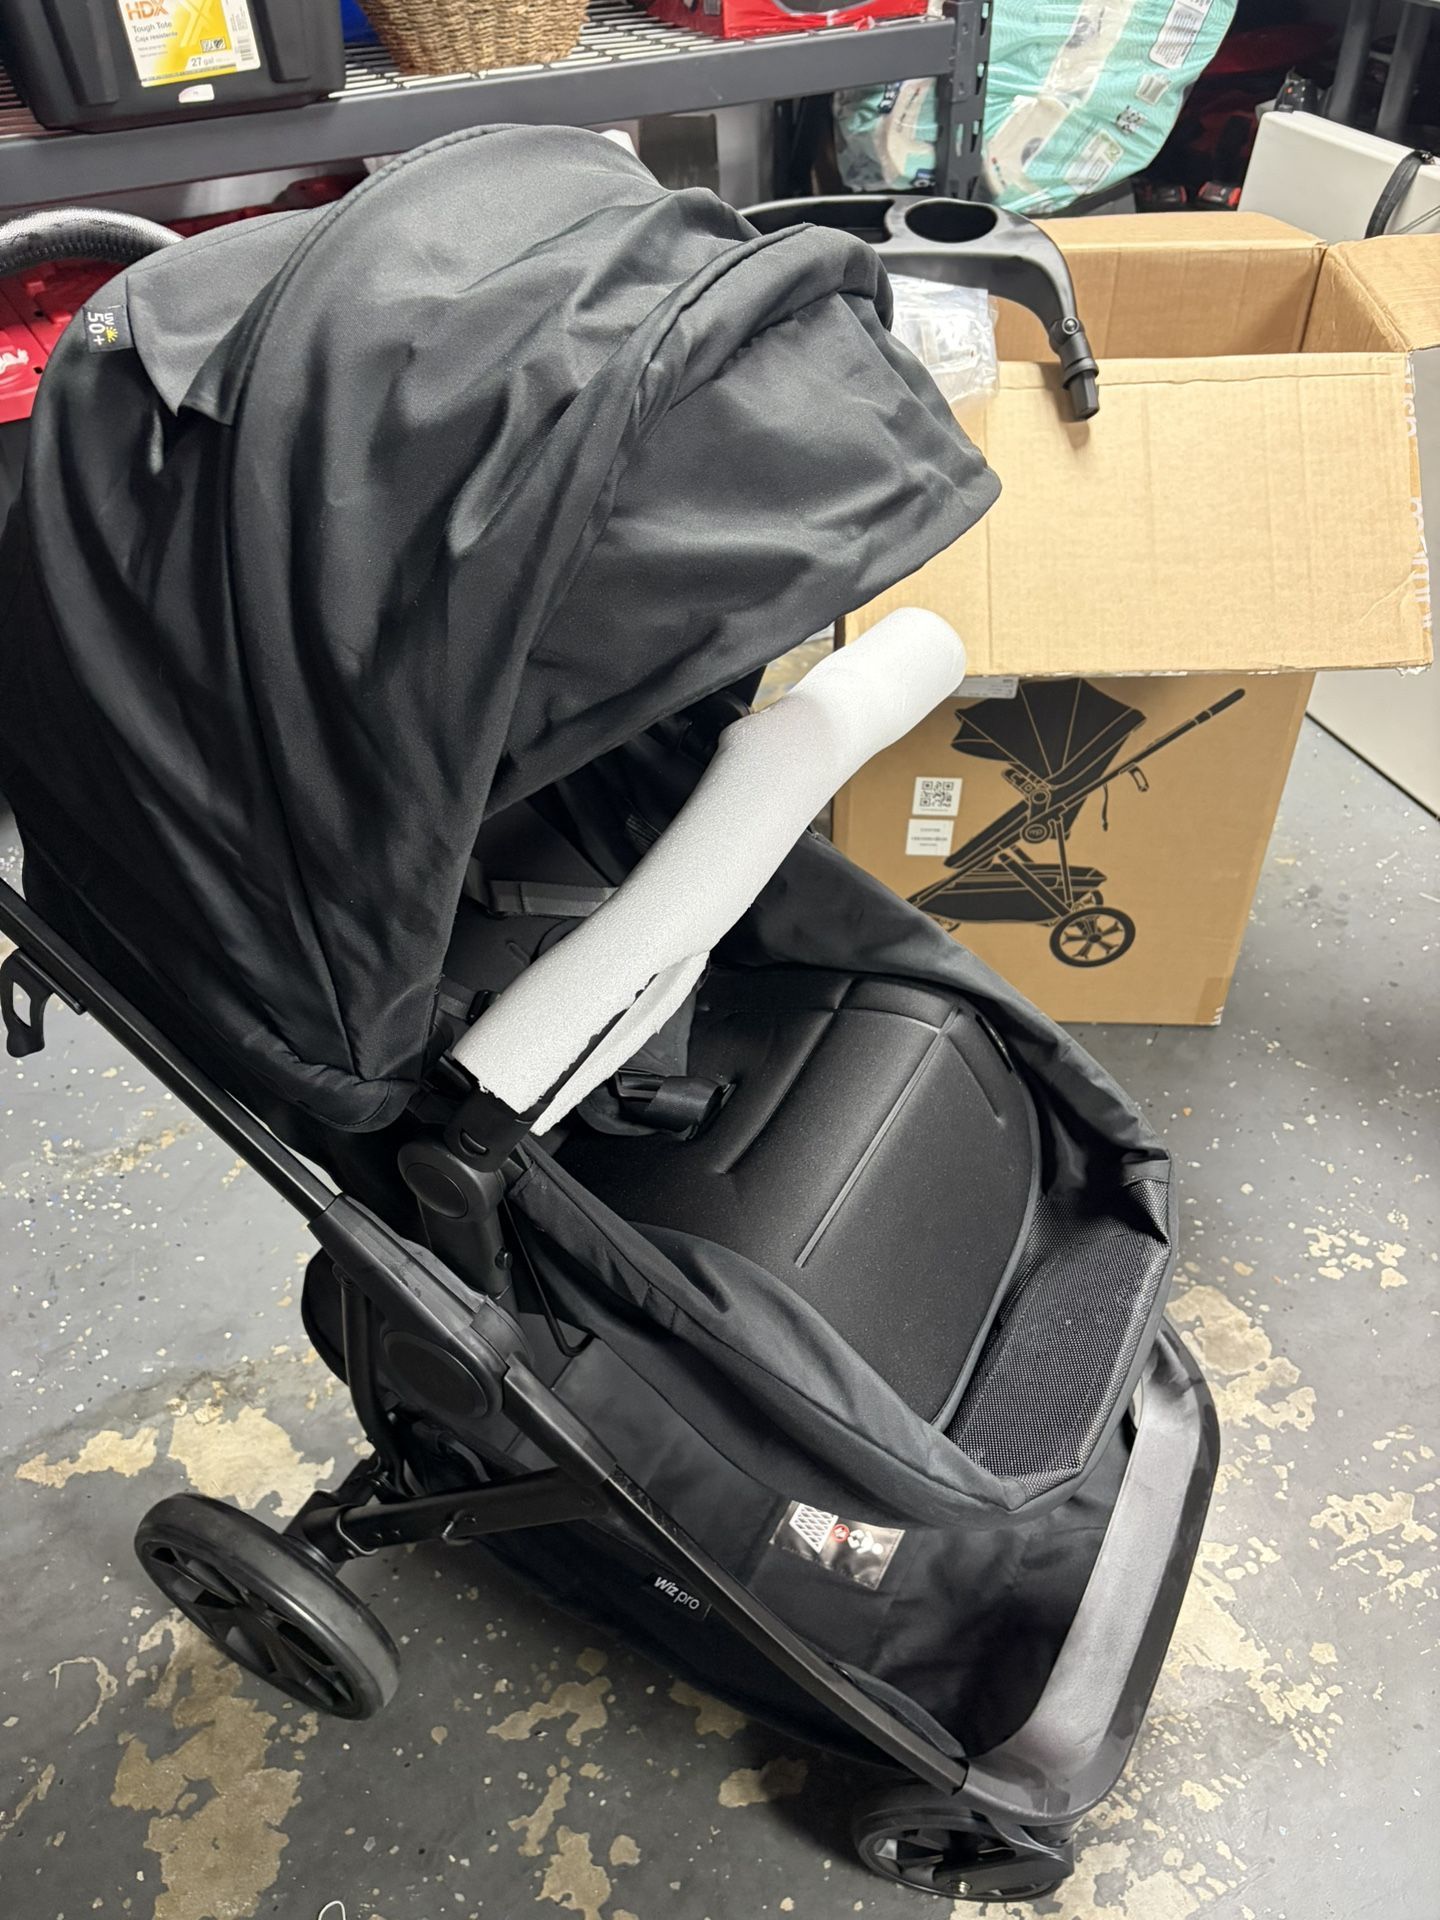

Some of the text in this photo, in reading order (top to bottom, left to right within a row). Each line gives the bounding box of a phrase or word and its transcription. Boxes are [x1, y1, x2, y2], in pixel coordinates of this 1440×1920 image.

[125, 0, 168, 20] HDX
[132, 20, 172, 34] Tough Tote
[191, 57, 202, 67] 27
[203, 57, 215, 66] gal
[104, 312, 115, 326] UV
[87, 311, 105, 346] 50+
